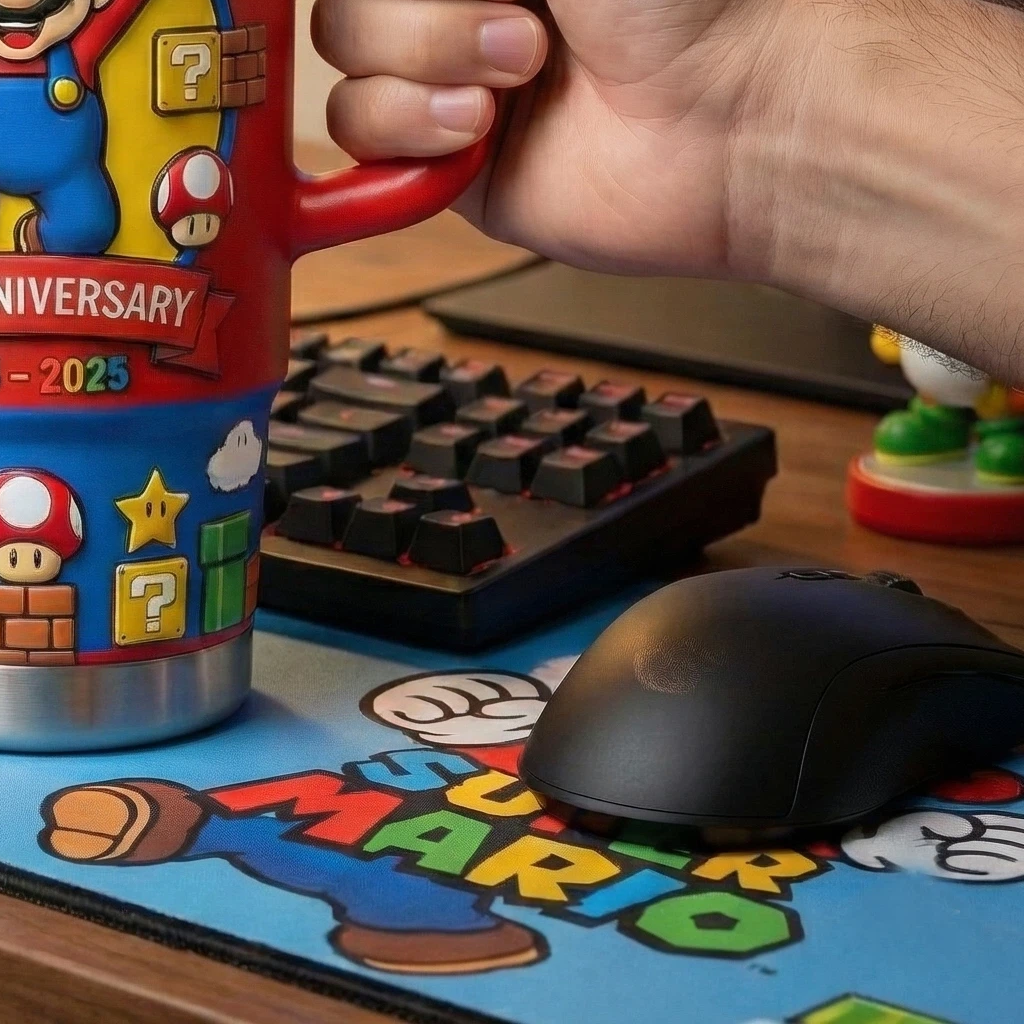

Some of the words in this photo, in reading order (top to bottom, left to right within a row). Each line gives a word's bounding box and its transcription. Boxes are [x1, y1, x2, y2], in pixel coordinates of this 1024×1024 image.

[171, 43, 211, 101] ?
[40, 356, 129, 394] 2025
[131, 572, 176, 633] ?
[356, 748, 818, 894] SUR
[208, 774, 792, 954] MARIO
